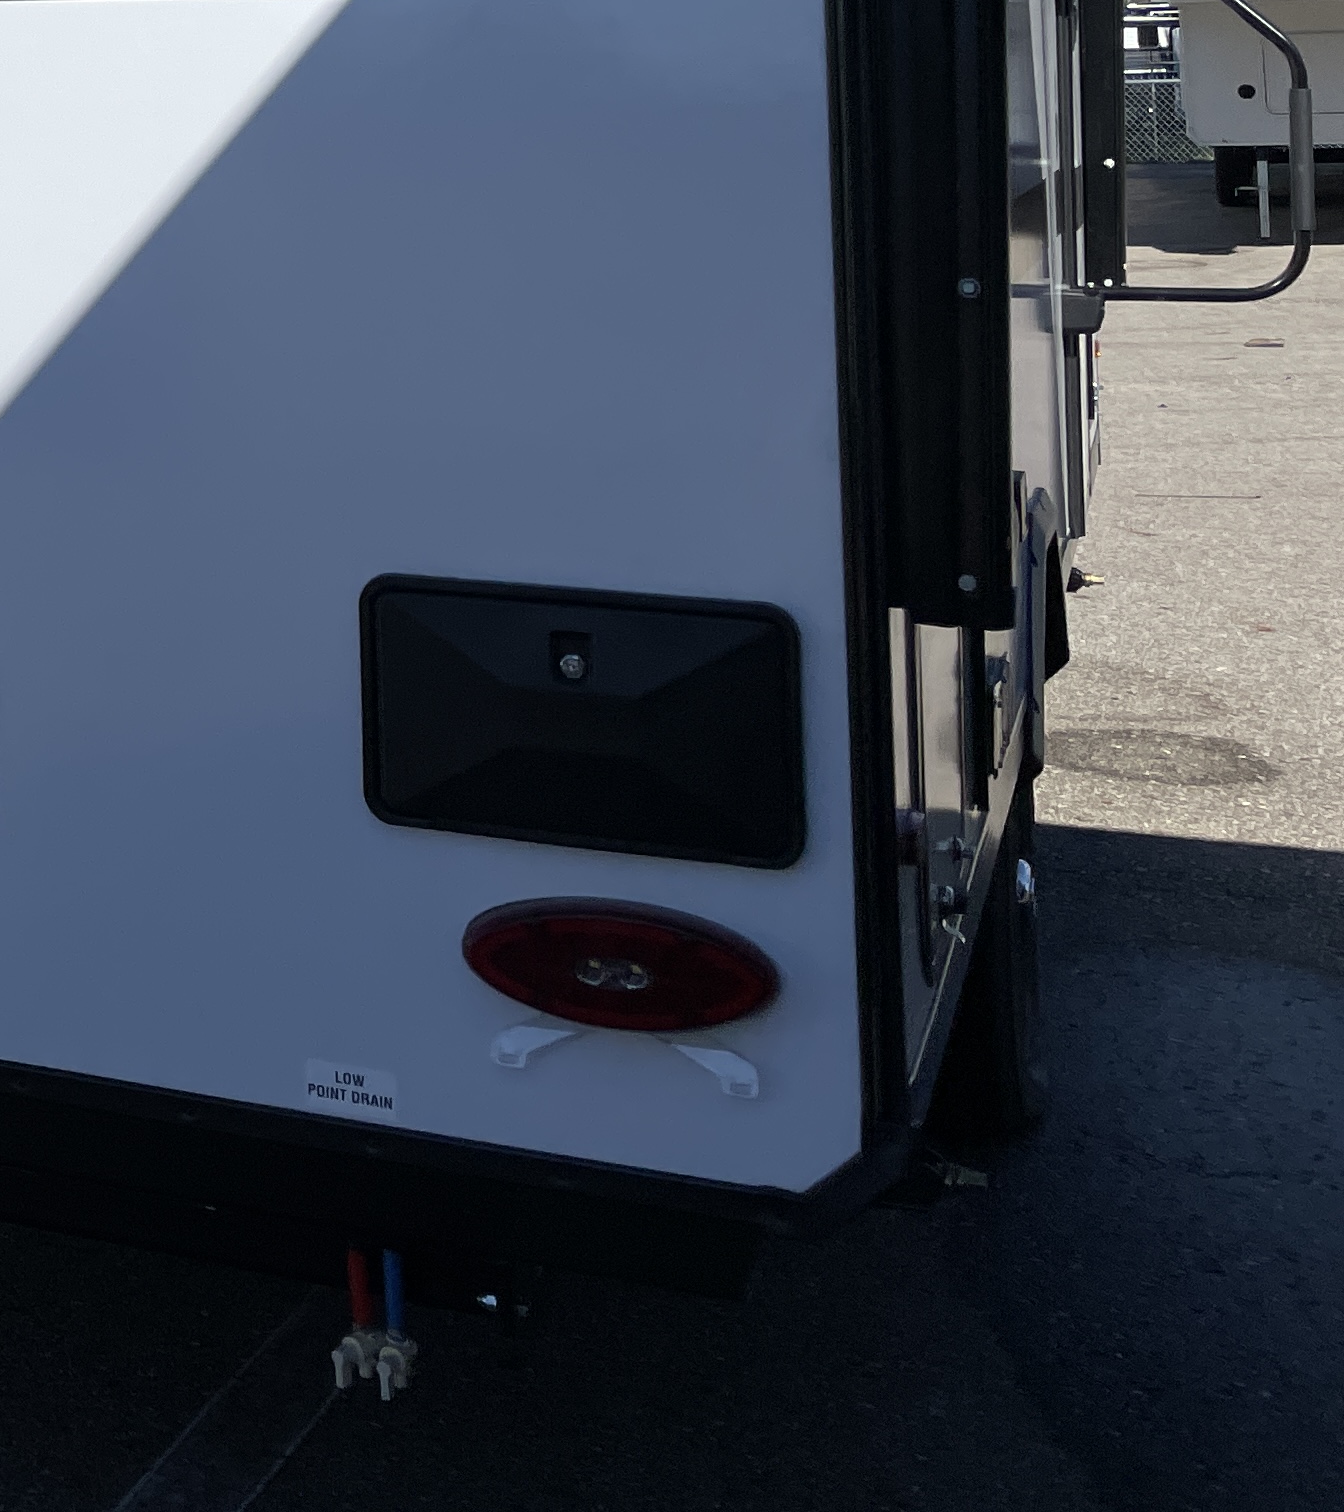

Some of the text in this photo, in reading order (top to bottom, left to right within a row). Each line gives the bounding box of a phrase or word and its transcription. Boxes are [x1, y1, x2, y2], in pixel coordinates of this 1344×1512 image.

[334, 1070, 365, 1088] LOW
[308, 1083, 393, 1110] POINT DRAIN
